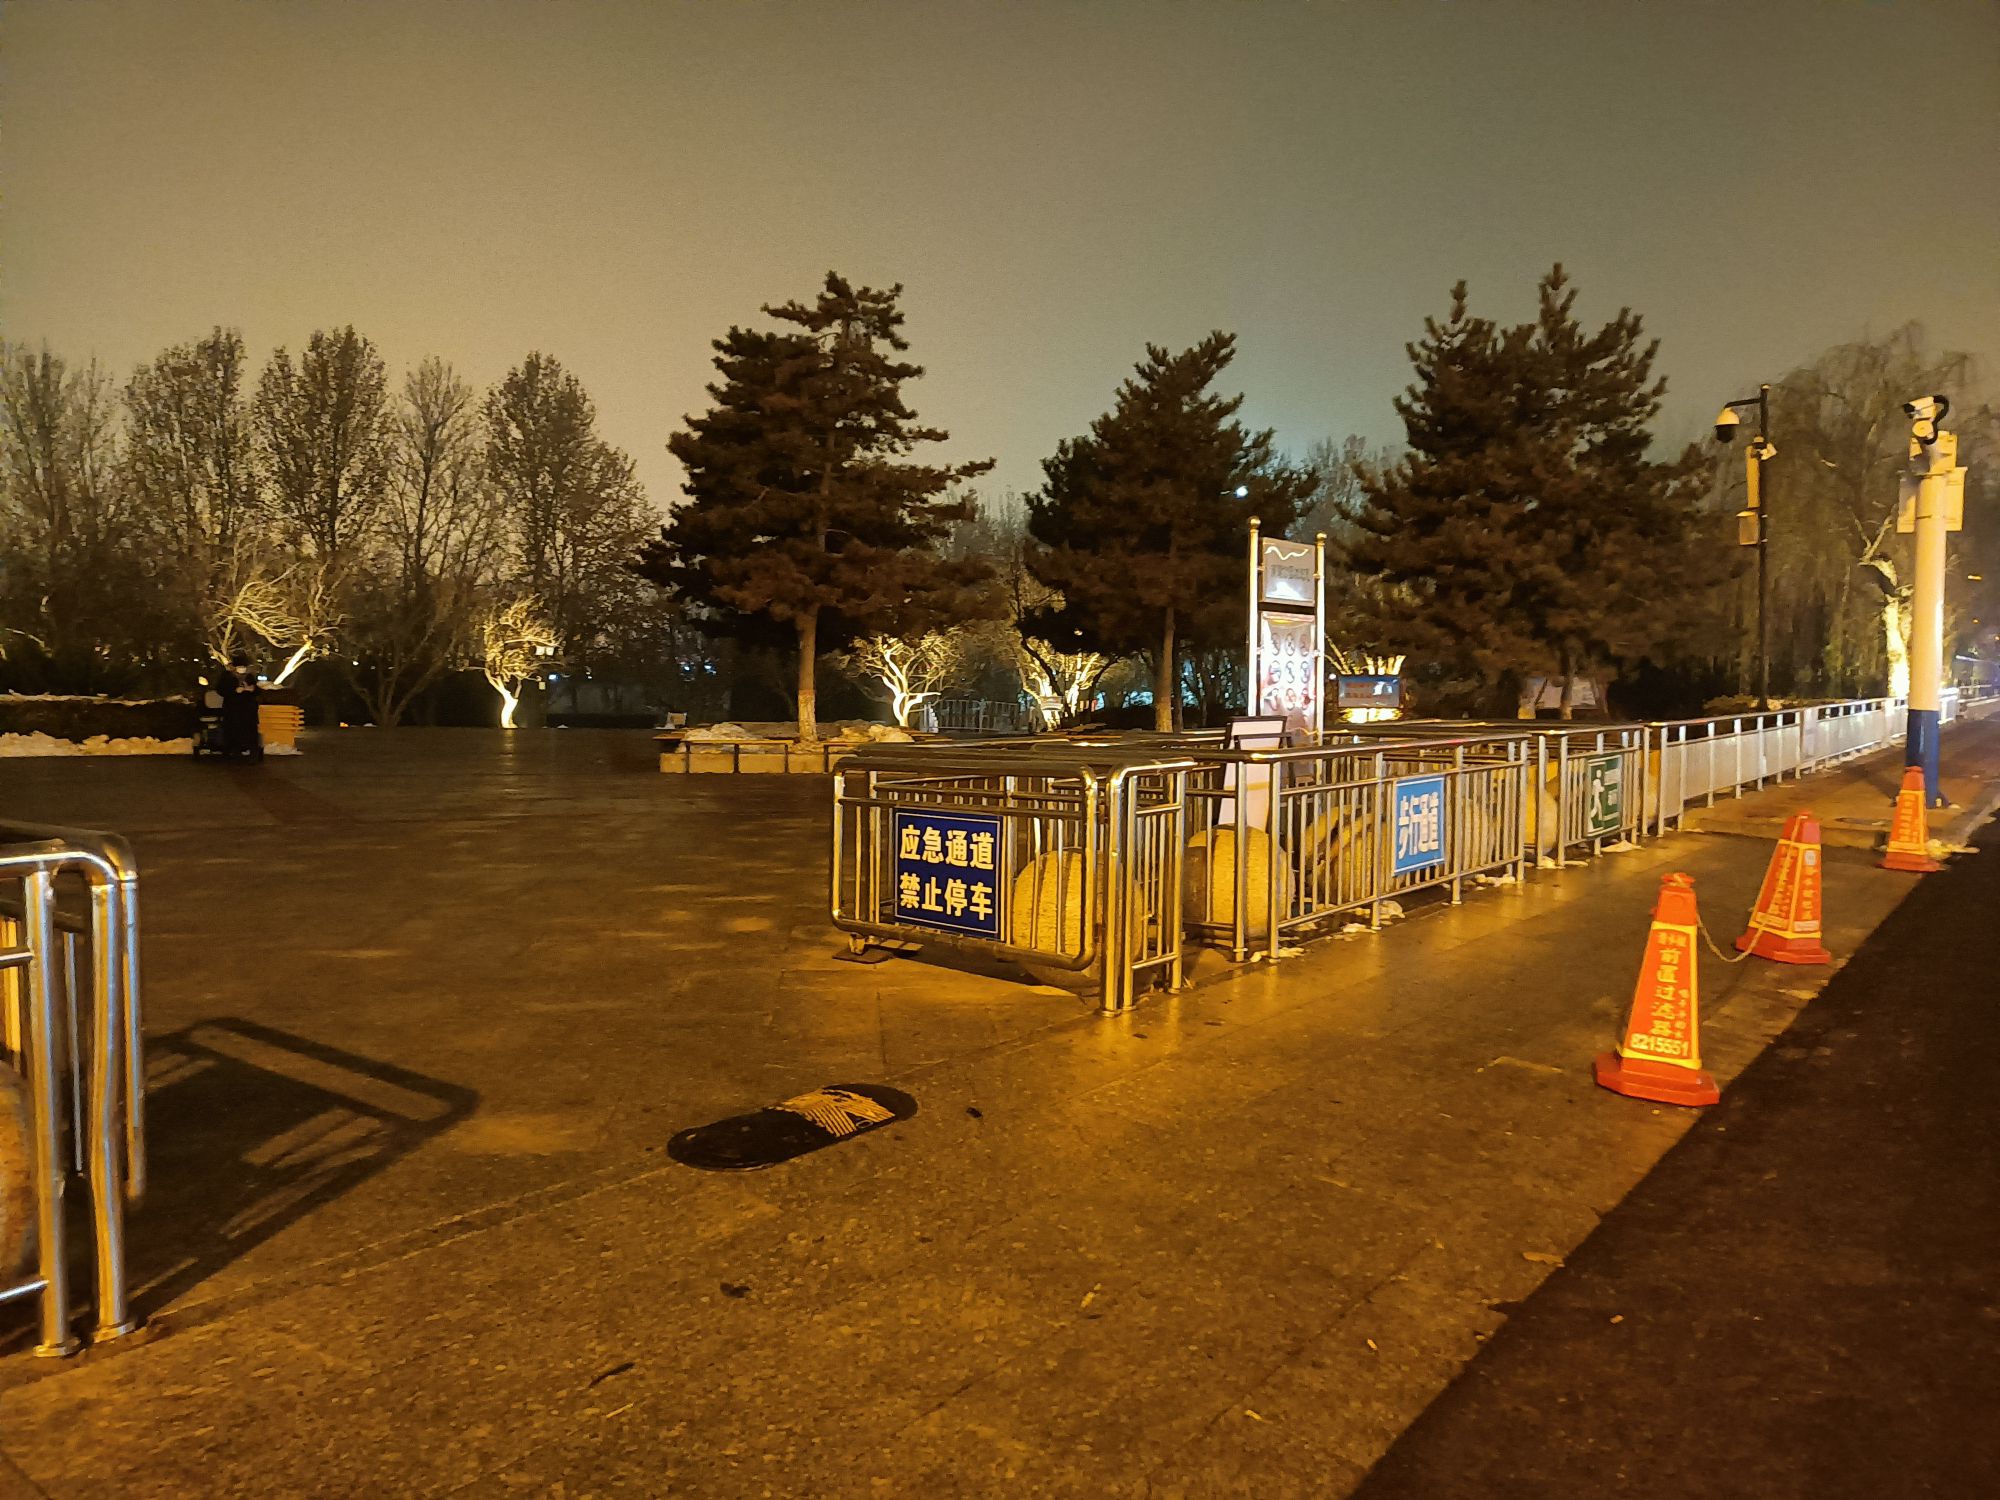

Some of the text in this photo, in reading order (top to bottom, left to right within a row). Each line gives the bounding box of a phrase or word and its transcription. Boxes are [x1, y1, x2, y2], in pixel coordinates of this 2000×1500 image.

[899, 824, 995, 870] 应急通道
[899, 871, 993, 921] 禁止停车
